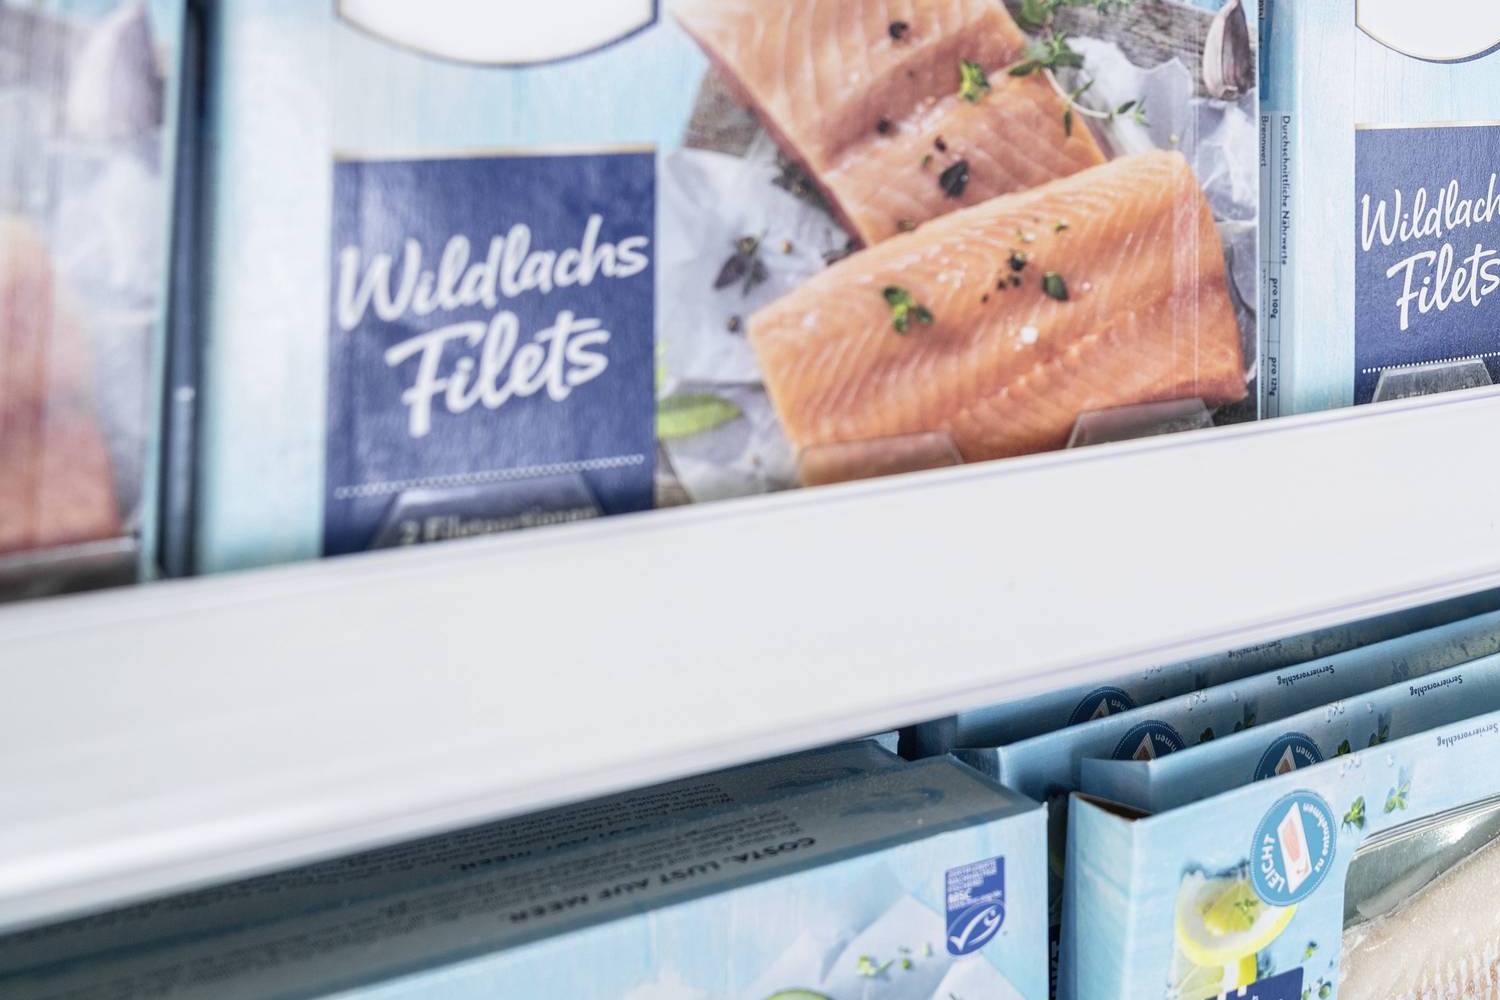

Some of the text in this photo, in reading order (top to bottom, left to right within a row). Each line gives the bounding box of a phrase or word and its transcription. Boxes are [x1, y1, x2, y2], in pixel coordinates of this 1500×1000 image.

[1280, 115, 1291, 266] Durchschnittliche Nährwerte
[338, 213, 650, 331] Wildlachs
[1270, 277, 1279, 320] pro 100g
[384, 310, 612, 439] Filets
[1268, 356, 1278, 376] pro
[1276, 664, 1335, 686] Serviervorschlag
[1409, 674, 1464, 697] Serviervorschlag
[1436, 722, 1499, 747] Serviervorschlag
[722, 836, 816, 865] COSTA.
[1261, 833, 1286, 893] LEICHT
[658, 859, 721, 884] LUST
[596, 878, 650, 901] AUF
